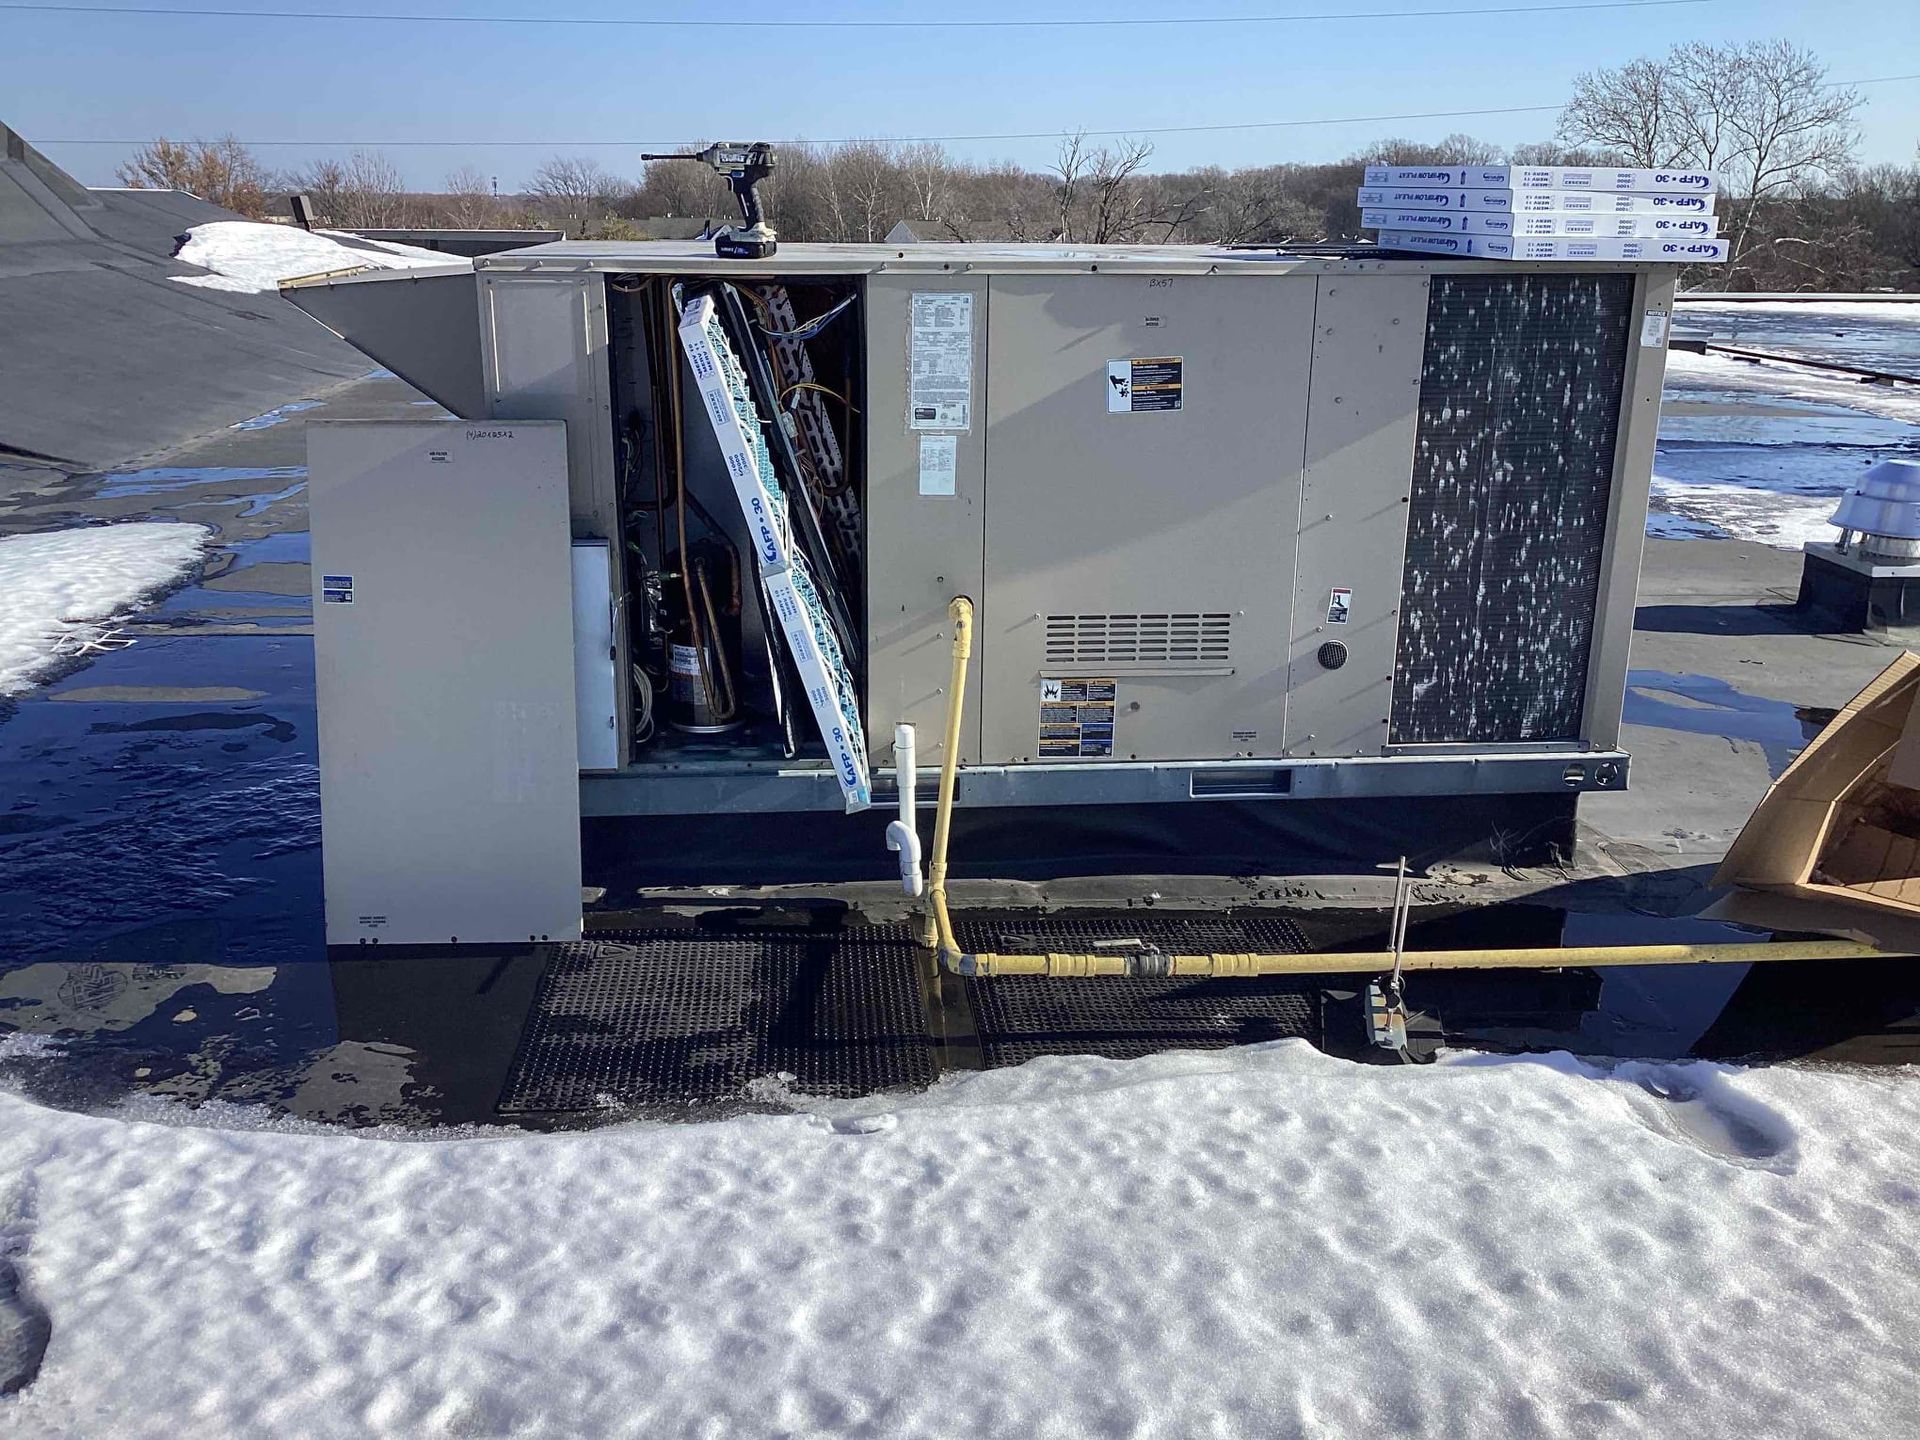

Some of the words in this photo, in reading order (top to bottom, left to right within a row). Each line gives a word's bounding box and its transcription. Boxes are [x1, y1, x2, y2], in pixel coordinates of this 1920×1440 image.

[1656, 221, 1670, 229] 30
[1663, 244, 1677, 252] 30
[688, 343, 694, 351] 10
[692, 355, 702, 374] MERV
[697, 353, 707, 372] MERV
[703, 351, 713, 370] MERV
[728, 455, 737, 471] 1000
[734, 454, 743, 472] 2000
[740, 452, 748, 468] 3000
[751, 497, 763, 514] 30
[832, 727, 843, 743] 30
